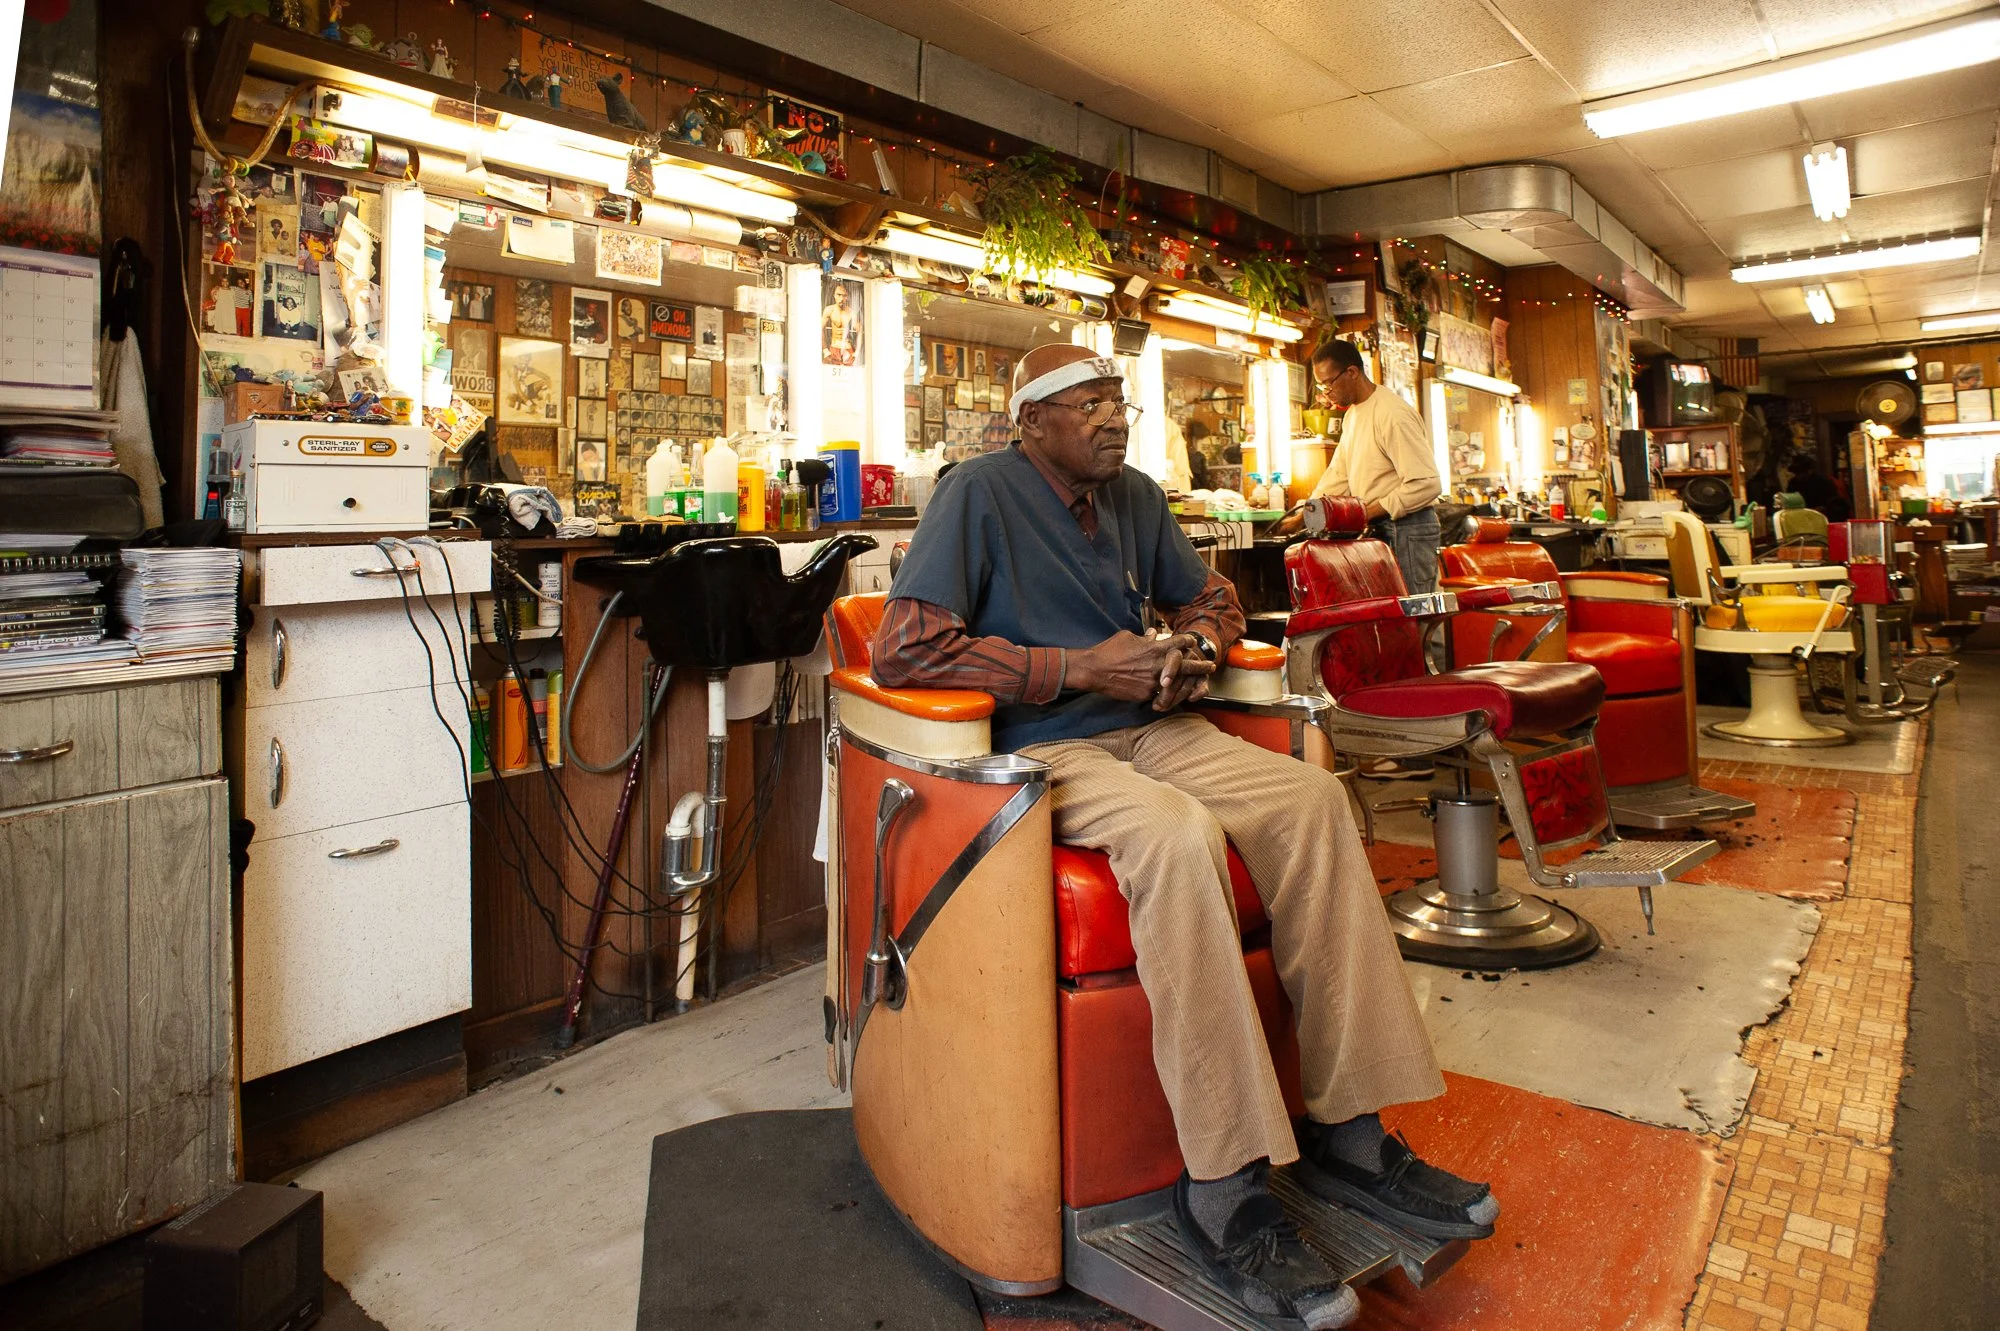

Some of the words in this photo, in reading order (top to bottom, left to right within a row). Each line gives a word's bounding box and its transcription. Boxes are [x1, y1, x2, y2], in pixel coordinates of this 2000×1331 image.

[538, 54, 560, 71] YOU
[562, 62, 585, 79] MUST
[561, 49, 575, 65] BE
[580, 55, 611, 74] NEXT
[788, 103, 825, 133] NO
[0, 622, 37, 631] PRIEST
